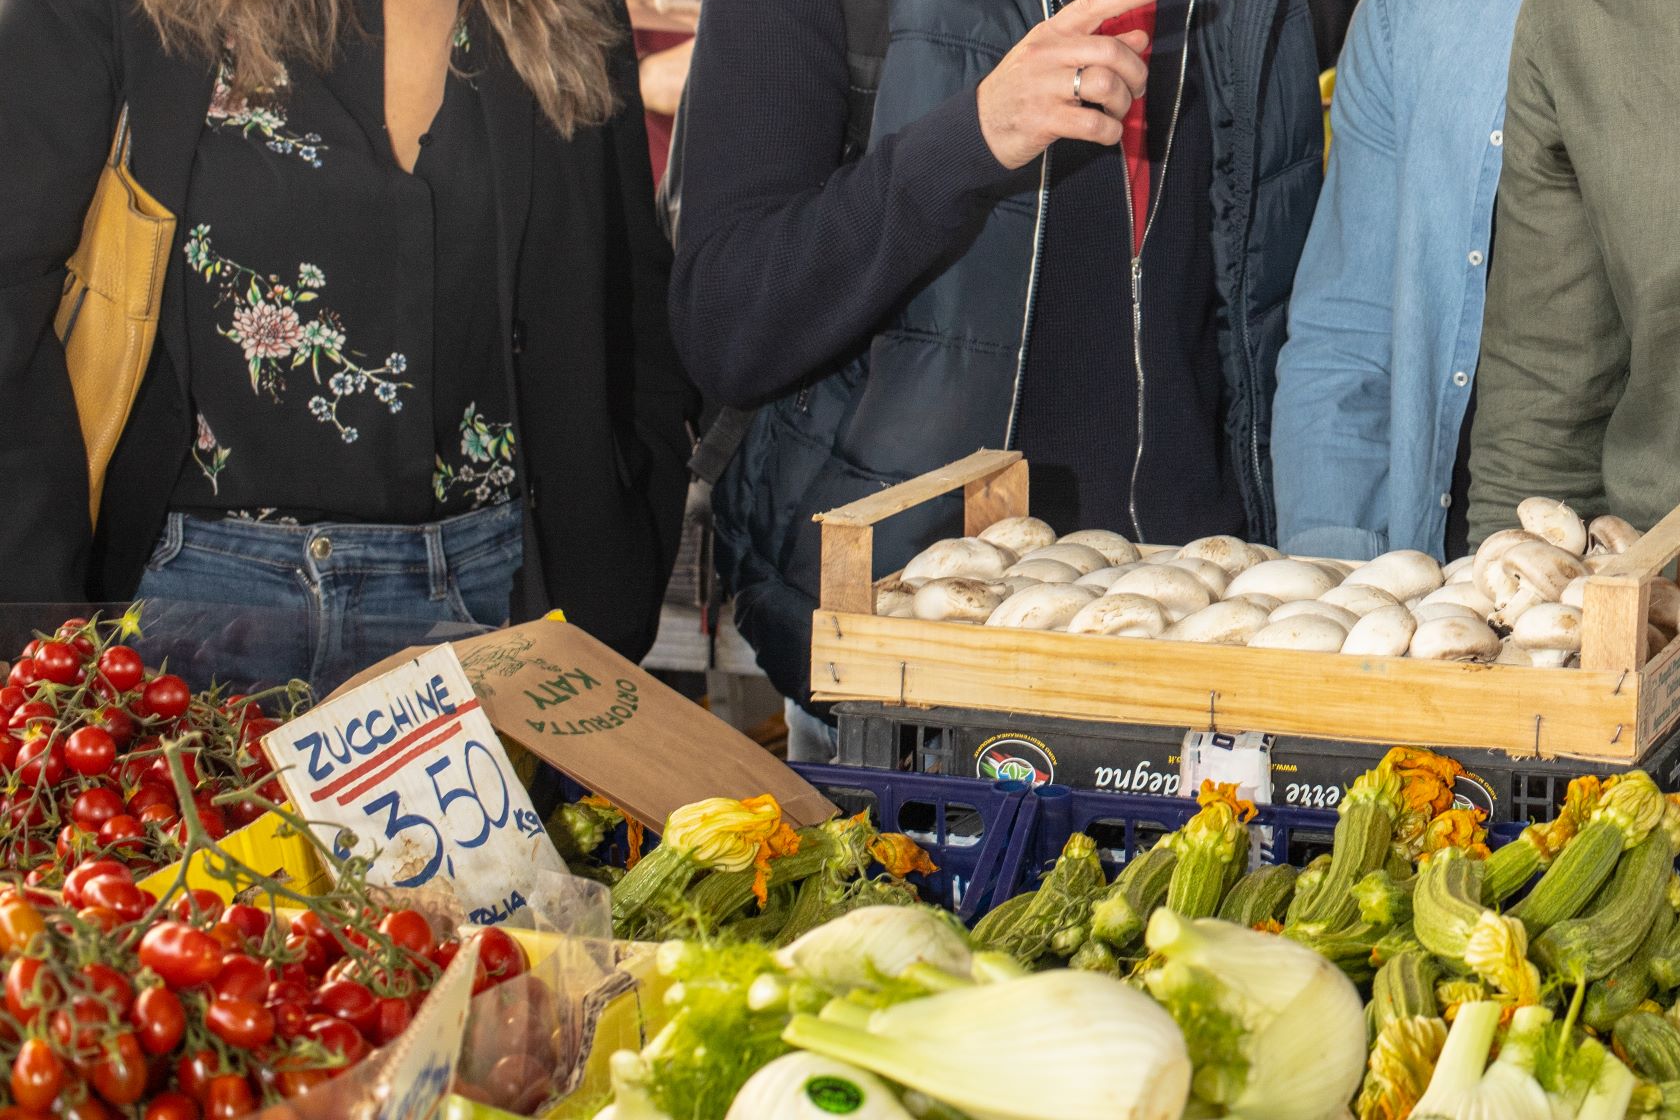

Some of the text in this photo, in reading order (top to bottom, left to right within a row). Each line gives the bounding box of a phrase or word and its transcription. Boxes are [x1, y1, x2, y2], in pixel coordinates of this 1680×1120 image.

[523, 667, 602, 711] KATY
[525, 678, 640, 735] ORTOFRUTTA
[292, 673, 457, 782] ZUCCHINE
[1094, 760, 1341, 810] erre degna
